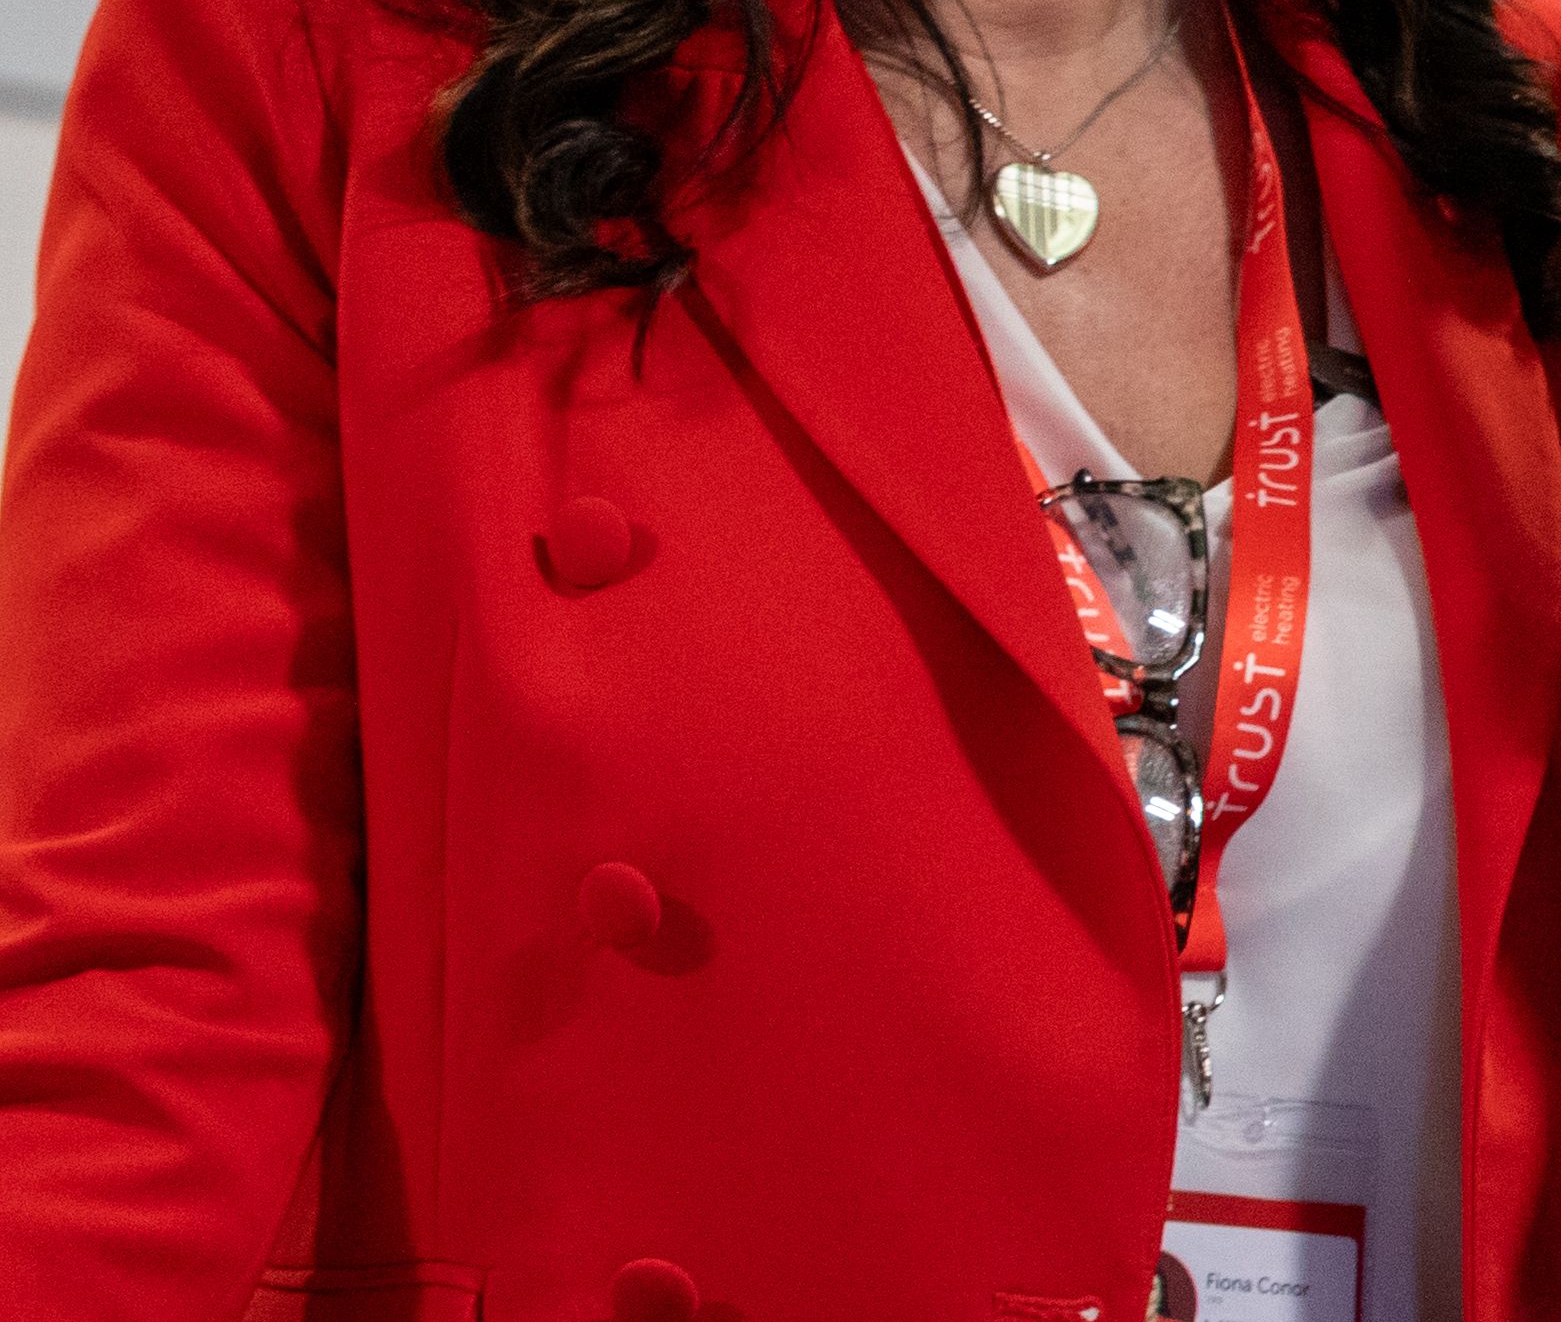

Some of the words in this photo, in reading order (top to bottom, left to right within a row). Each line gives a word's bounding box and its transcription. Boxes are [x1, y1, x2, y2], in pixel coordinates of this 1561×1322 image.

[1244, 411, 1301, 508] trust
[1251, 574, 1275, 643] electric
[1271, 575, 1301, 646] heating
[1205, 652, 1287, 821] trust
[1206, 1272, 1252, 1293] Fiona
